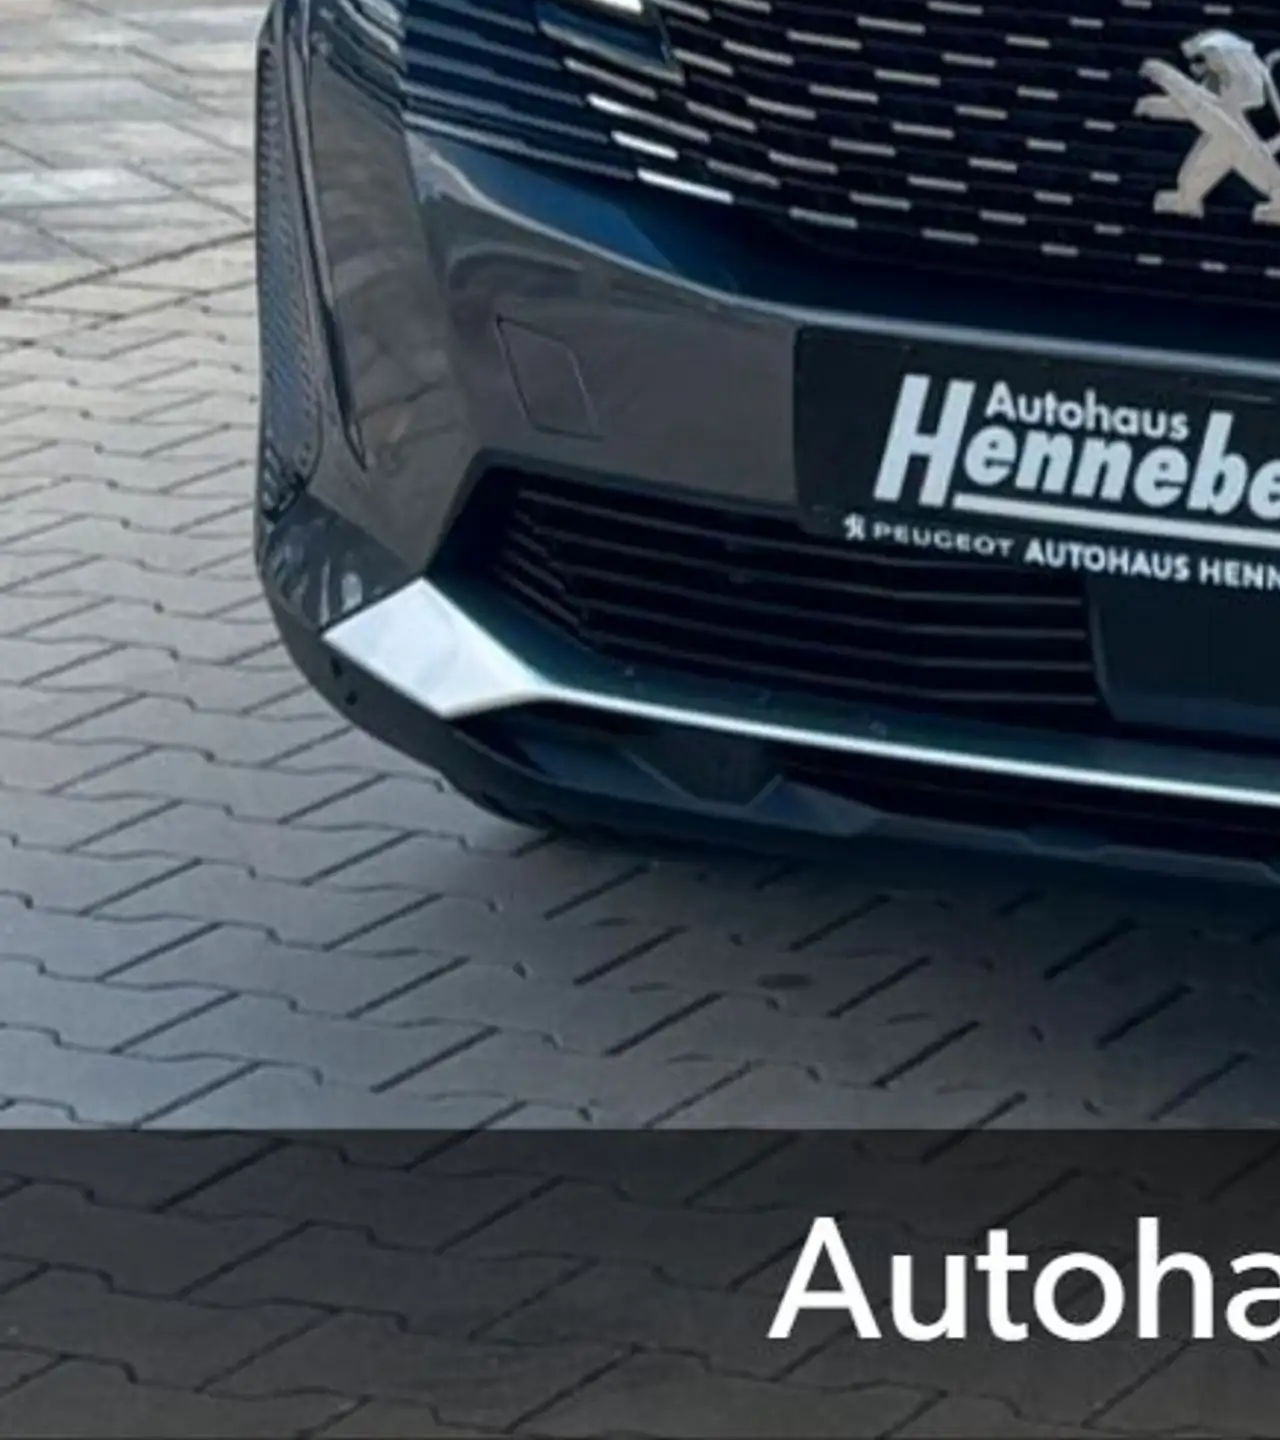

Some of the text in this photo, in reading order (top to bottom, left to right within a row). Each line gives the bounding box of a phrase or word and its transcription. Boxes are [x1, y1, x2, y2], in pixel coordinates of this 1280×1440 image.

[984, 381, 1191, 442] Autohaus
[873, 520, 1015, 558] PEUGEOT
[1024, 538, 1191, 582] AUTOHAUS
